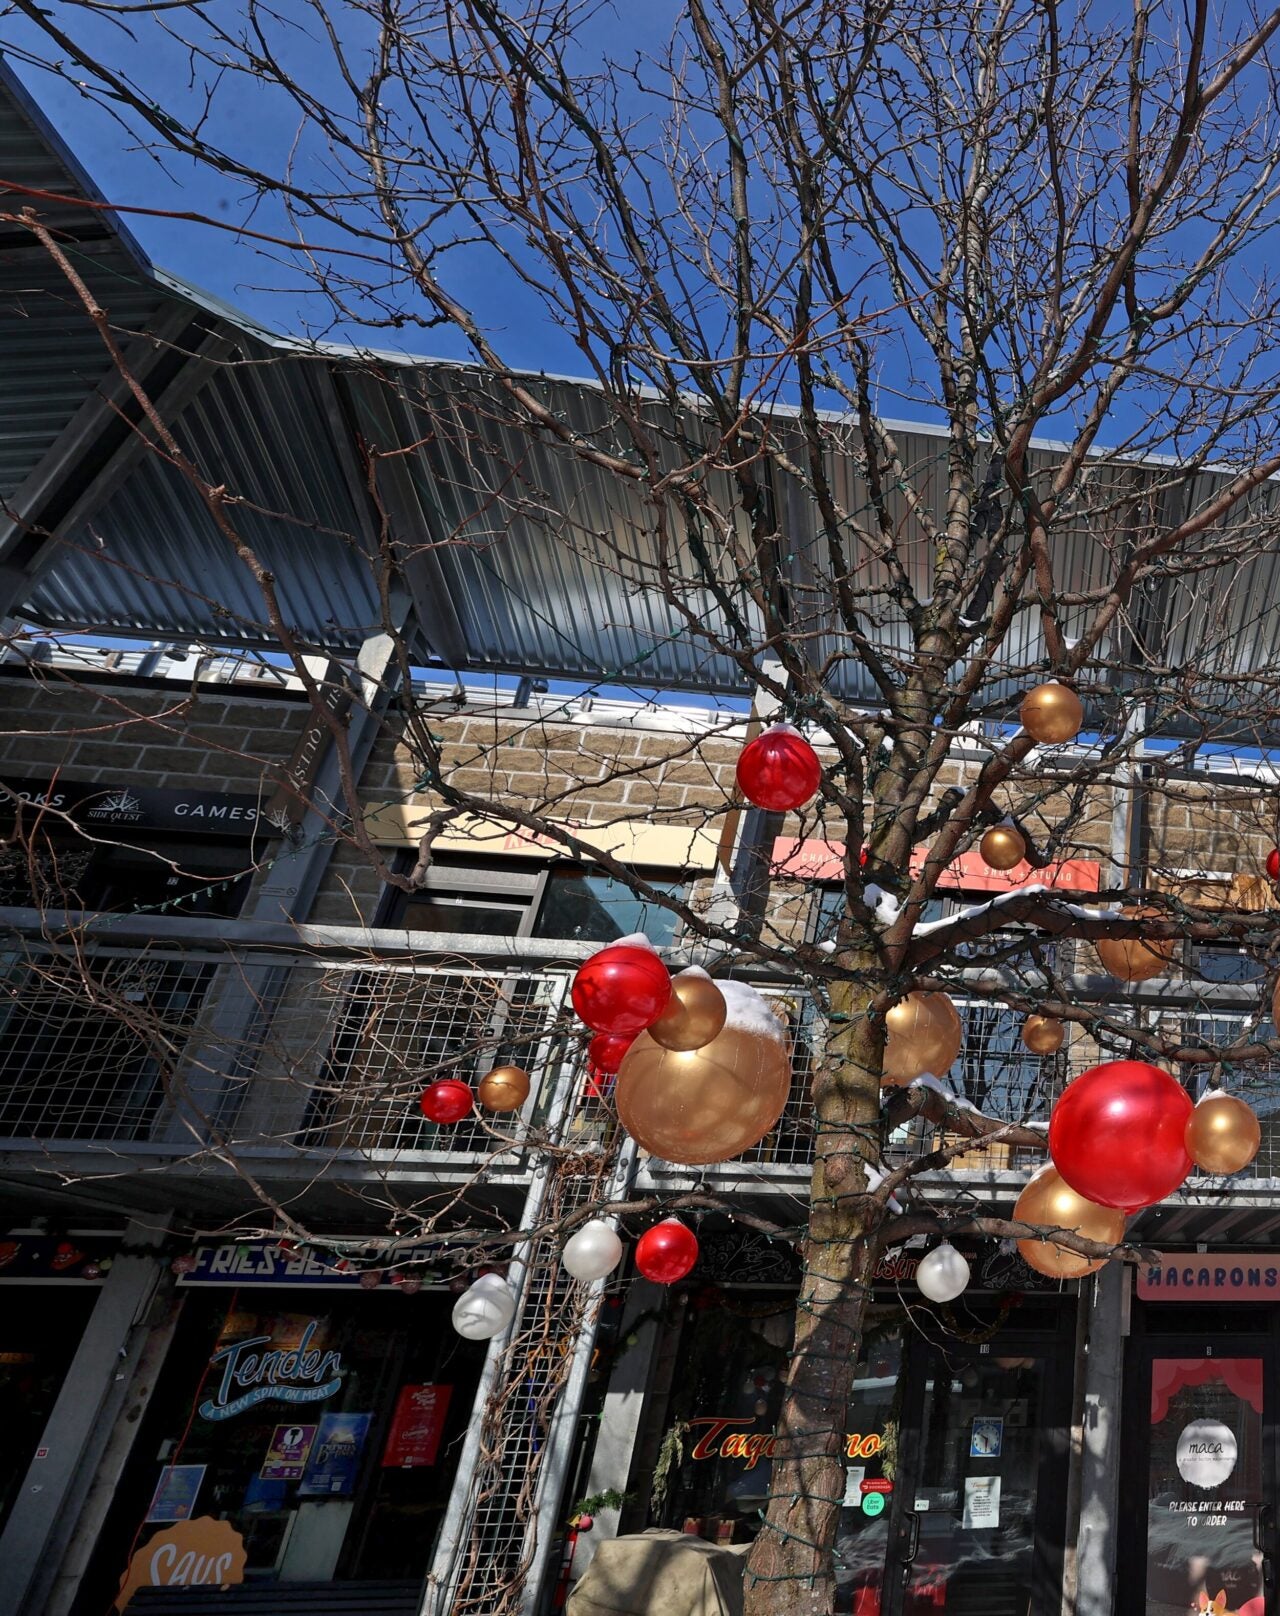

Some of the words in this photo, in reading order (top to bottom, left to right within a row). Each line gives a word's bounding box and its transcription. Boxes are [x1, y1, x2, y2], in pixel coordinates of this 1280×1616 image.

[174, 803, 258, 821] GAMES
[1147, 1266, 1279, 1288] MACARONS
[209, 1320, 341, 1405] Tender
[219, 1397, 250, 1417] NEW
[253, 1386, 283, 1401] SPIN
[285, 1389, 299, 1399] ON
[304, 1385, 331, 1401] MEAT
[1188, 1442, 1224, 1454] maca
[1168, 1501, 1197, 1512] PLEASE
[1198, 1501, 1222, 1511] ENTER
[1224, 1501, 1246, 1511] HERE
[1187, 1516, 1198, 1526] TO
